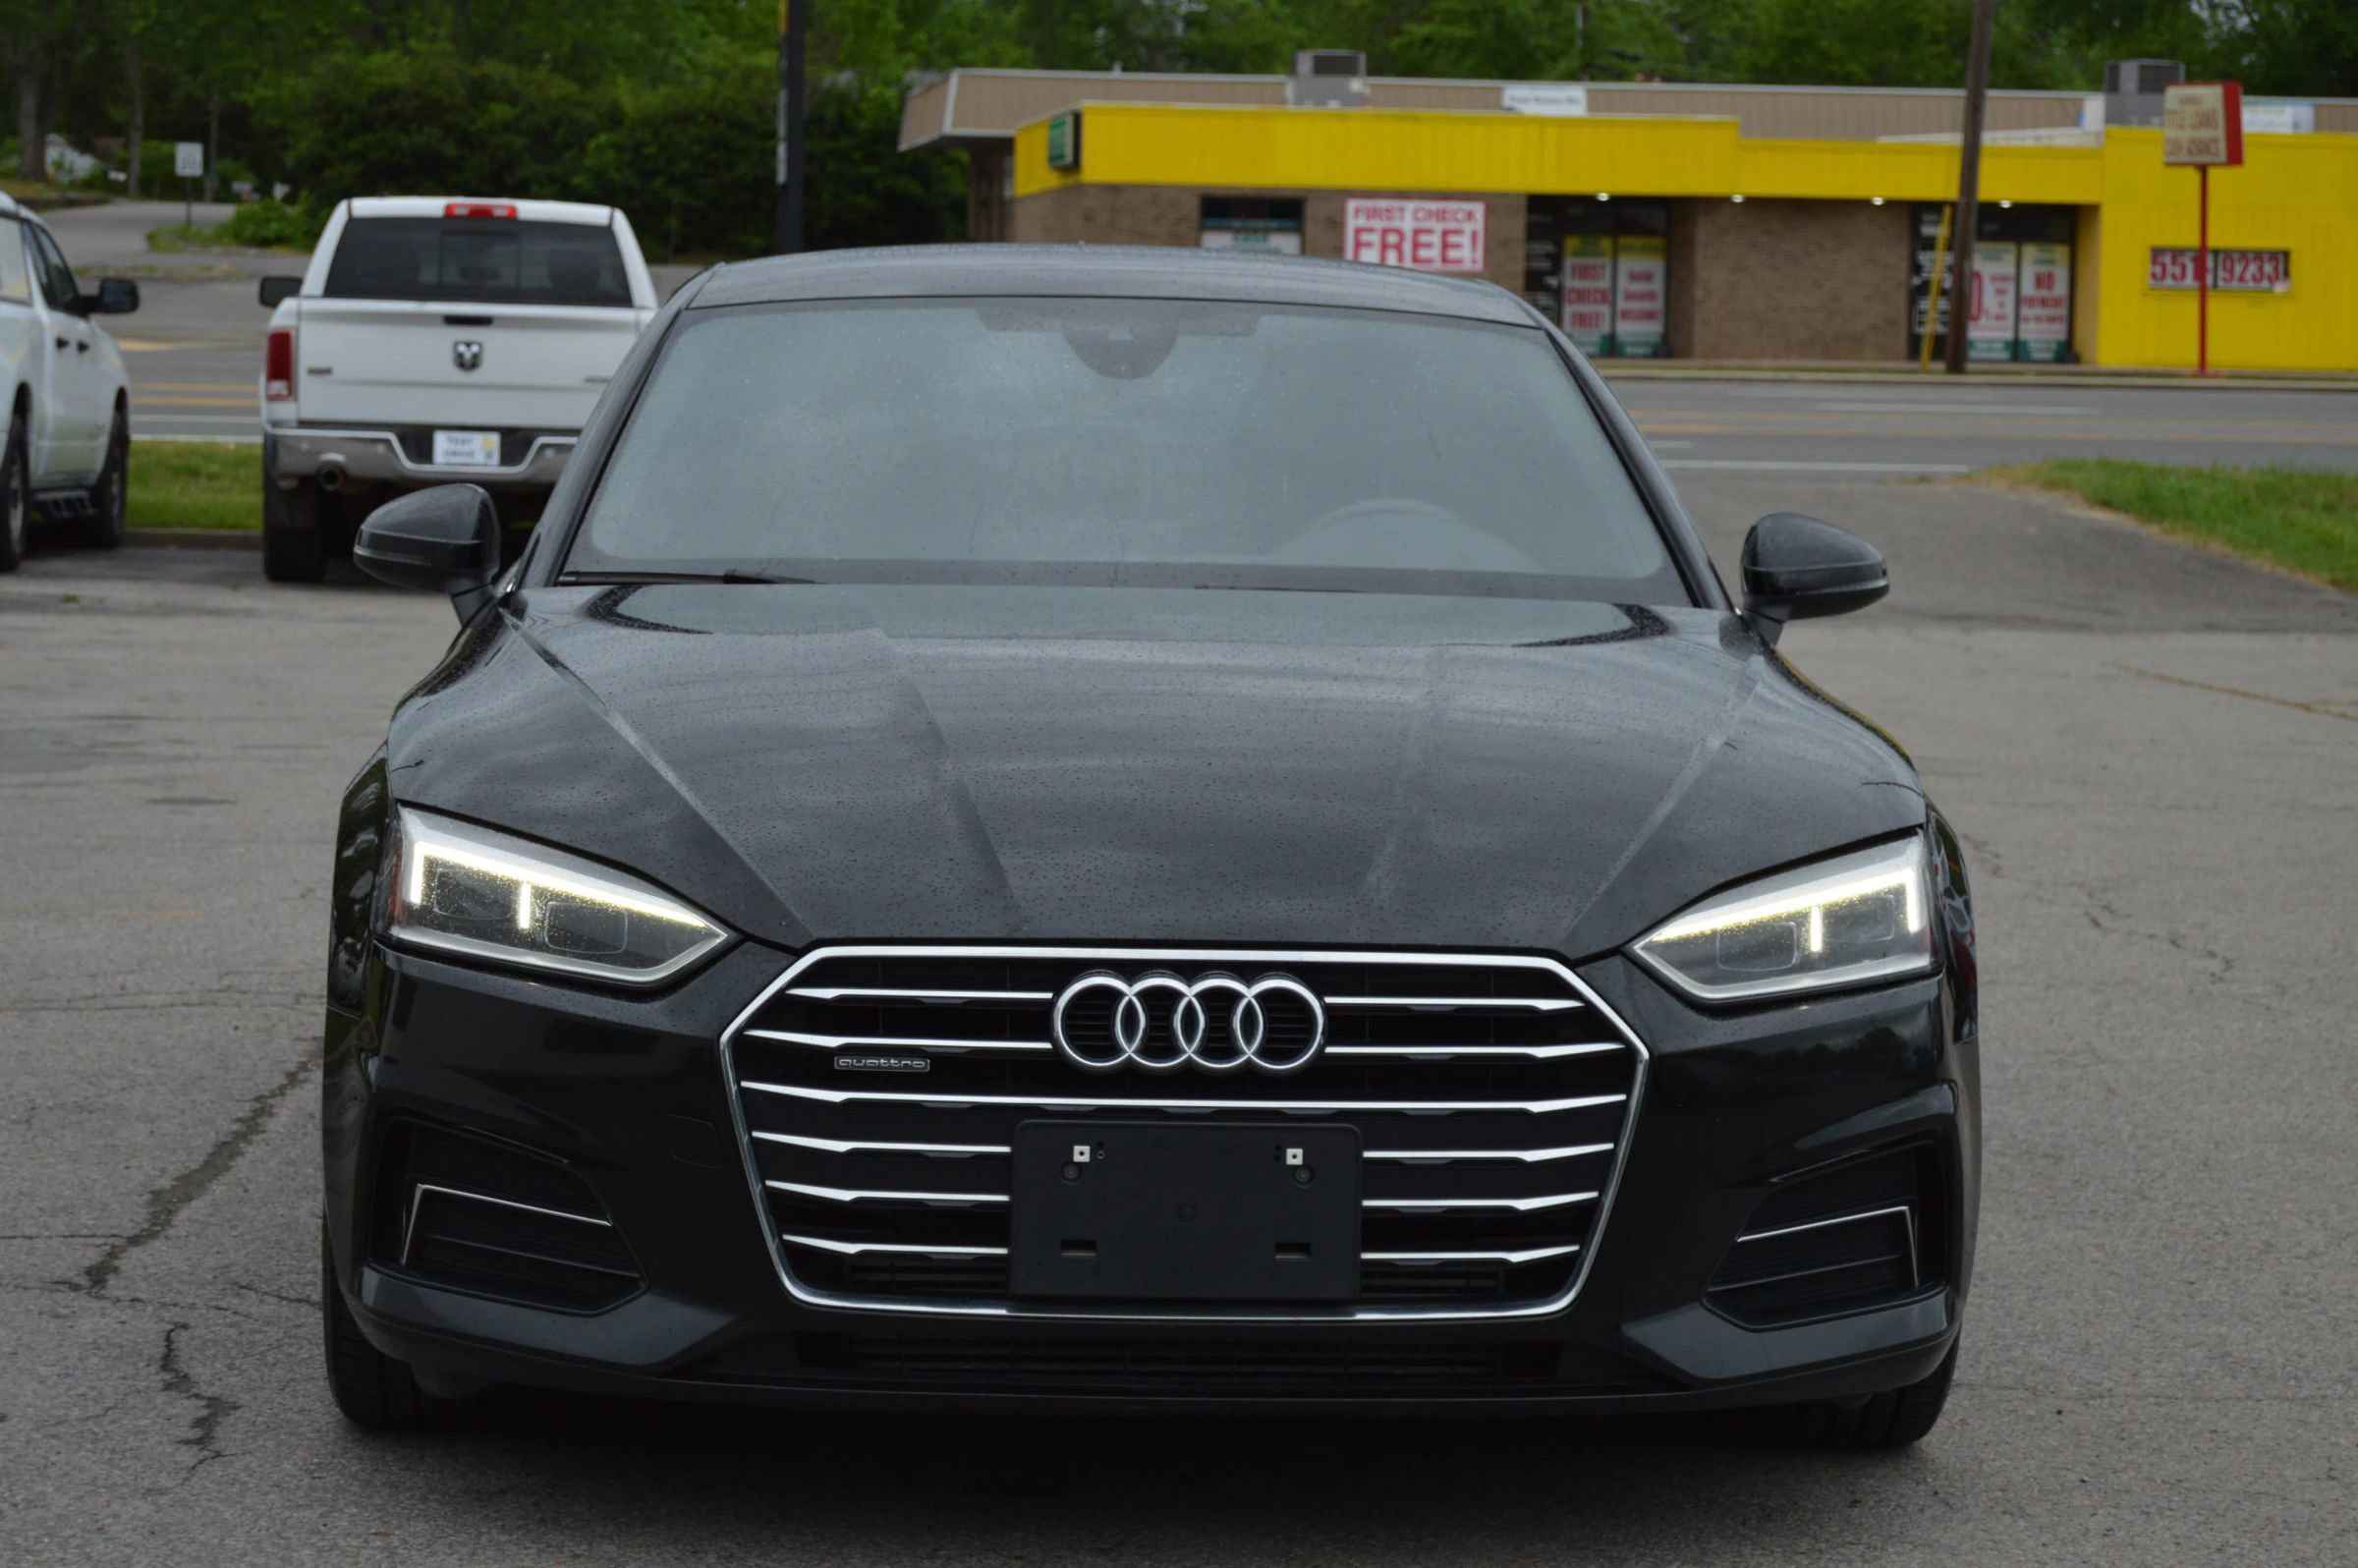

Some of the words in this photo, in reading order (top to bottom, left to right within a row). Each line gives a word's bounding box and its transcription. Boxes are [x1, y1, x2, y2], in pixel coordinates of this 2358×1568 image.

[1353, 204, 1406, 222] FIRST
[1412, 205, 1478, 223] CHECK
[1352, 226, 1480, 265] FREE!
[1570, 262, 1606, 282] FIRST
[2033, 270, 2055, 292] NO
[1566, 287, 1609, 305] CHECK
[838, 1058, 926, 1069] quattro
